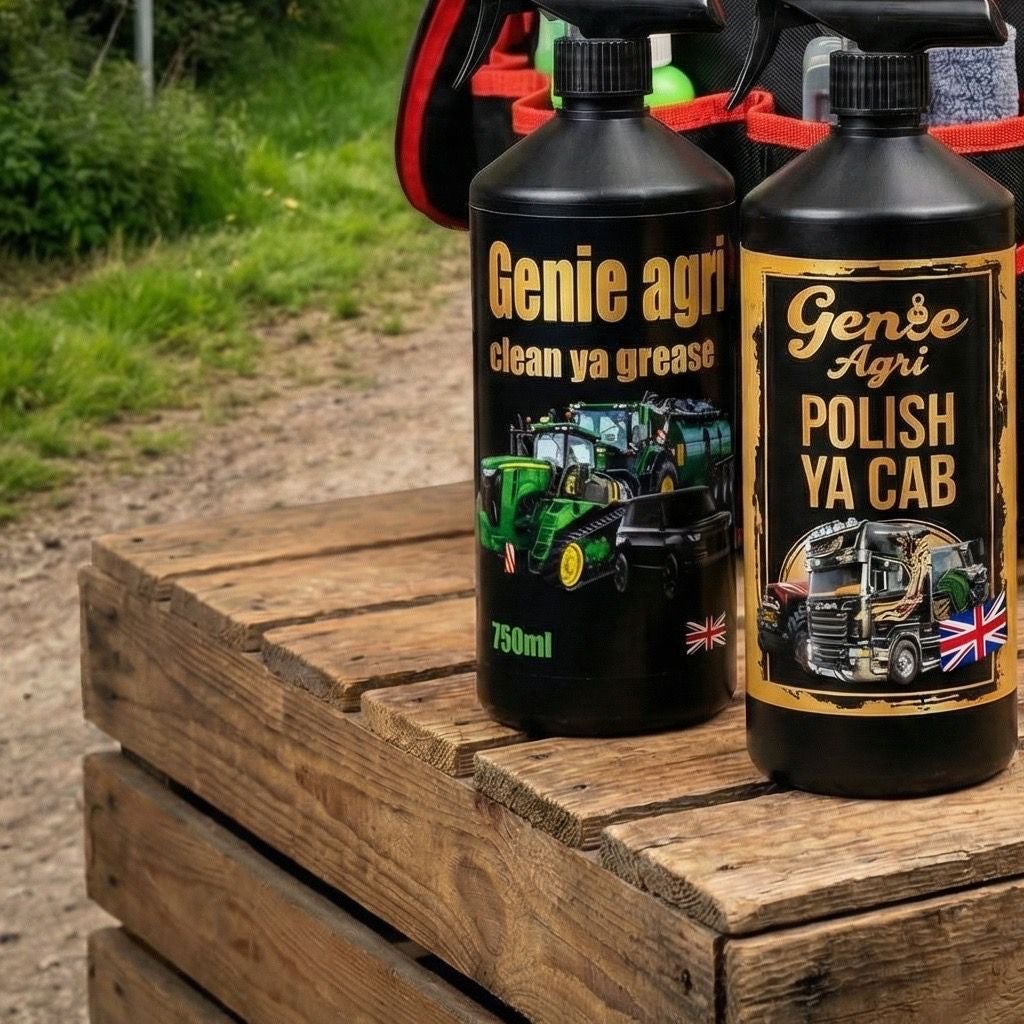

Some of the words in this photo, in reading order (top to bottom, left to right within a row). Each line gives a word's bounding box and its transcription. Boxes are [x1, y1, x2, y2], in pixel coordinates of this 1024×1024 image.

[489, 241, 627, 322] Genie
[643, 235, 724, 328] agri
[787, 285, 968, 359] Genie
[490, 337, 562, 377] clean
[570, 349, 608, 382] ya
[616, 339, 714, 382] grease
[827, 345, 929, 388] Agri
[802, 392, 954, 449] POLISH
[801, 454, 854, 509] YA
[869, 454, 956, 510] CAB
[492, 622, 551, 657] 750ml
